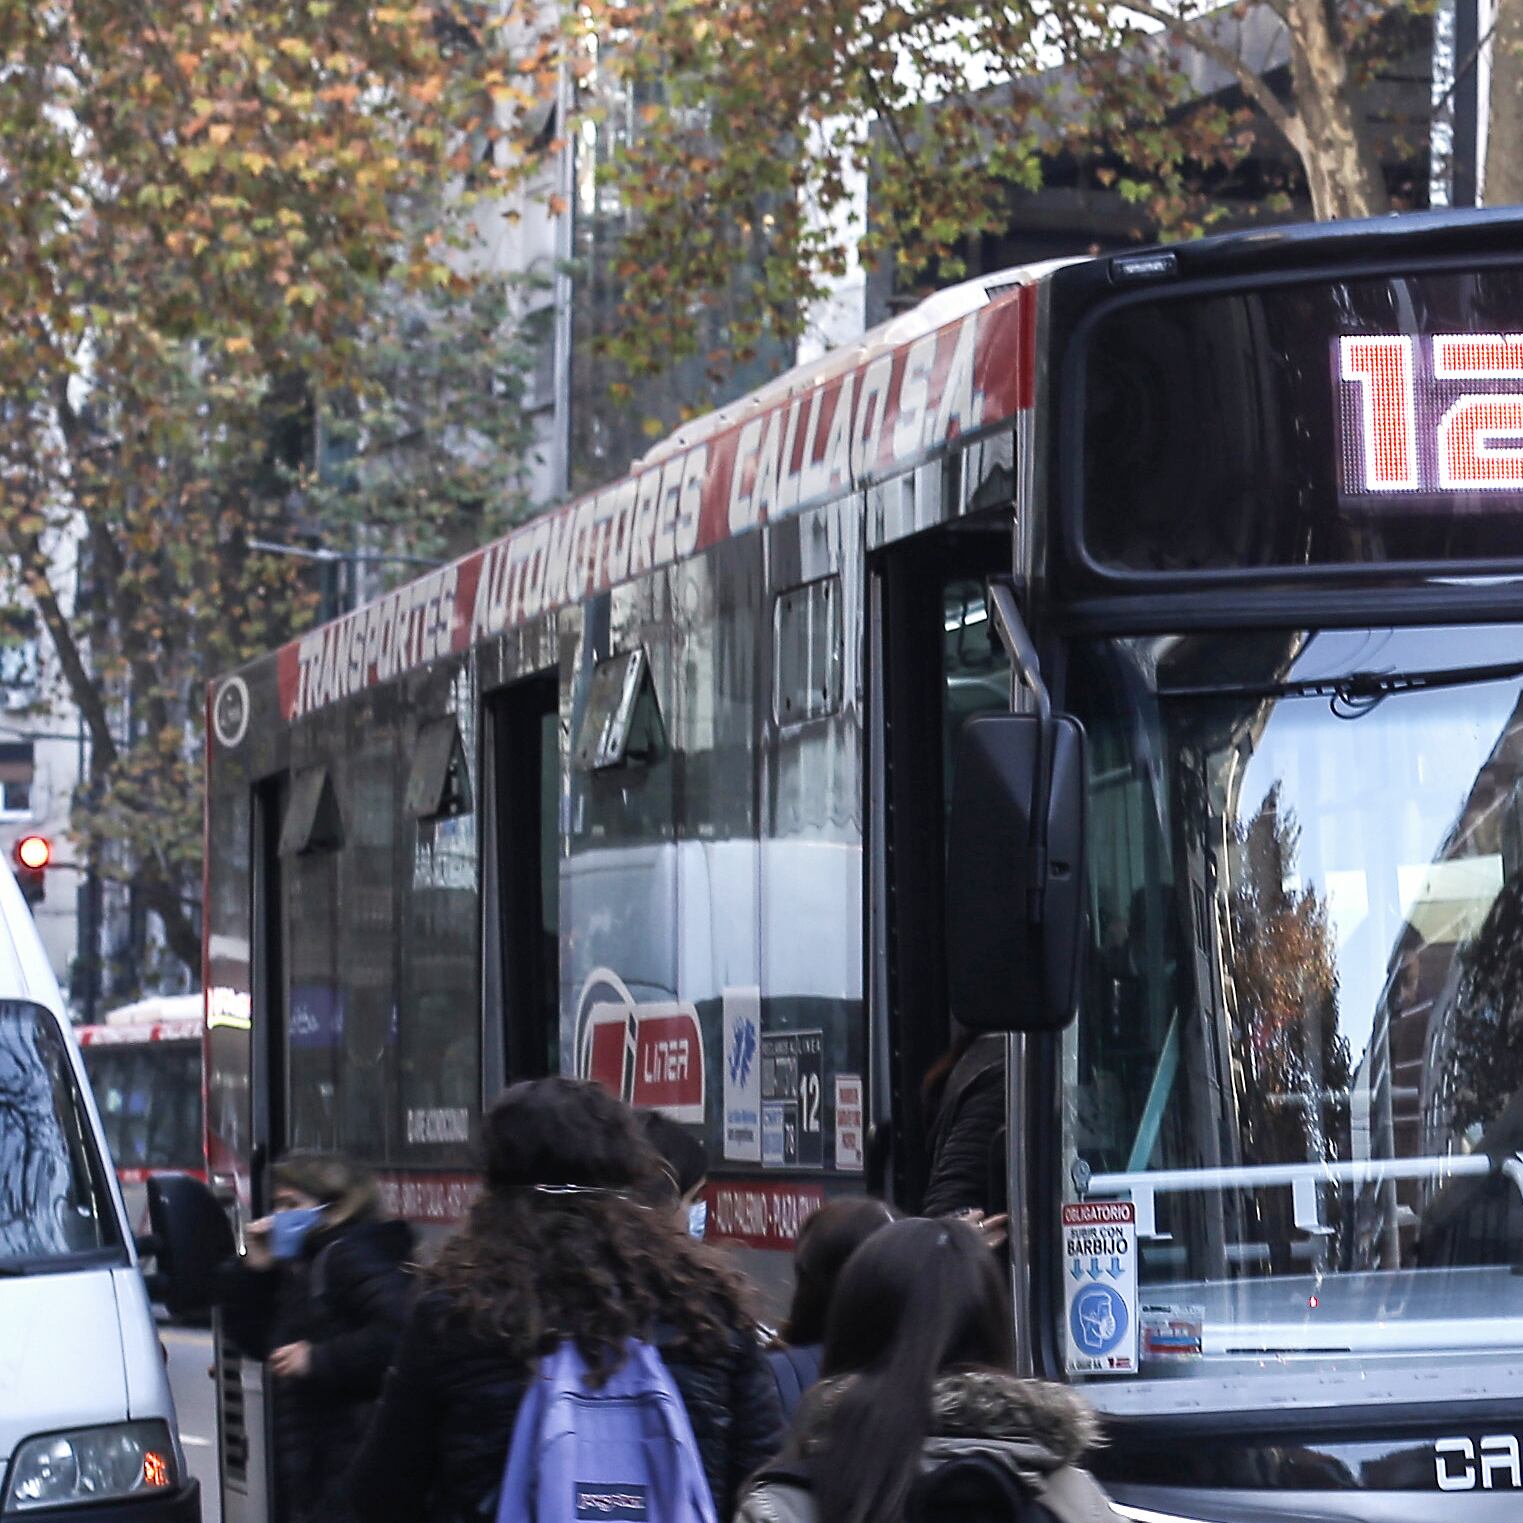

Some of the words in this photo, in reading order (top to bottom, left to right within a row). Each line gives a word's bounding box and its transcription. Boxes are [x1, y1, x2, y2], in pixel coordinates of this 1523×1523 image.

[297, 564, 458, 716] TRANSPORTES
[470, 443, 708, 645] AUTOMOTORES
[728, 352, 893, 537] CALLAO
[893, 311, 984, 455] S.A.
[800, 1072, 820, 1133] 12
[1065, 1204, 1131, 1222] OBLIGATORIO
[1067, 1238, 1129, 1256] BARBIJO
